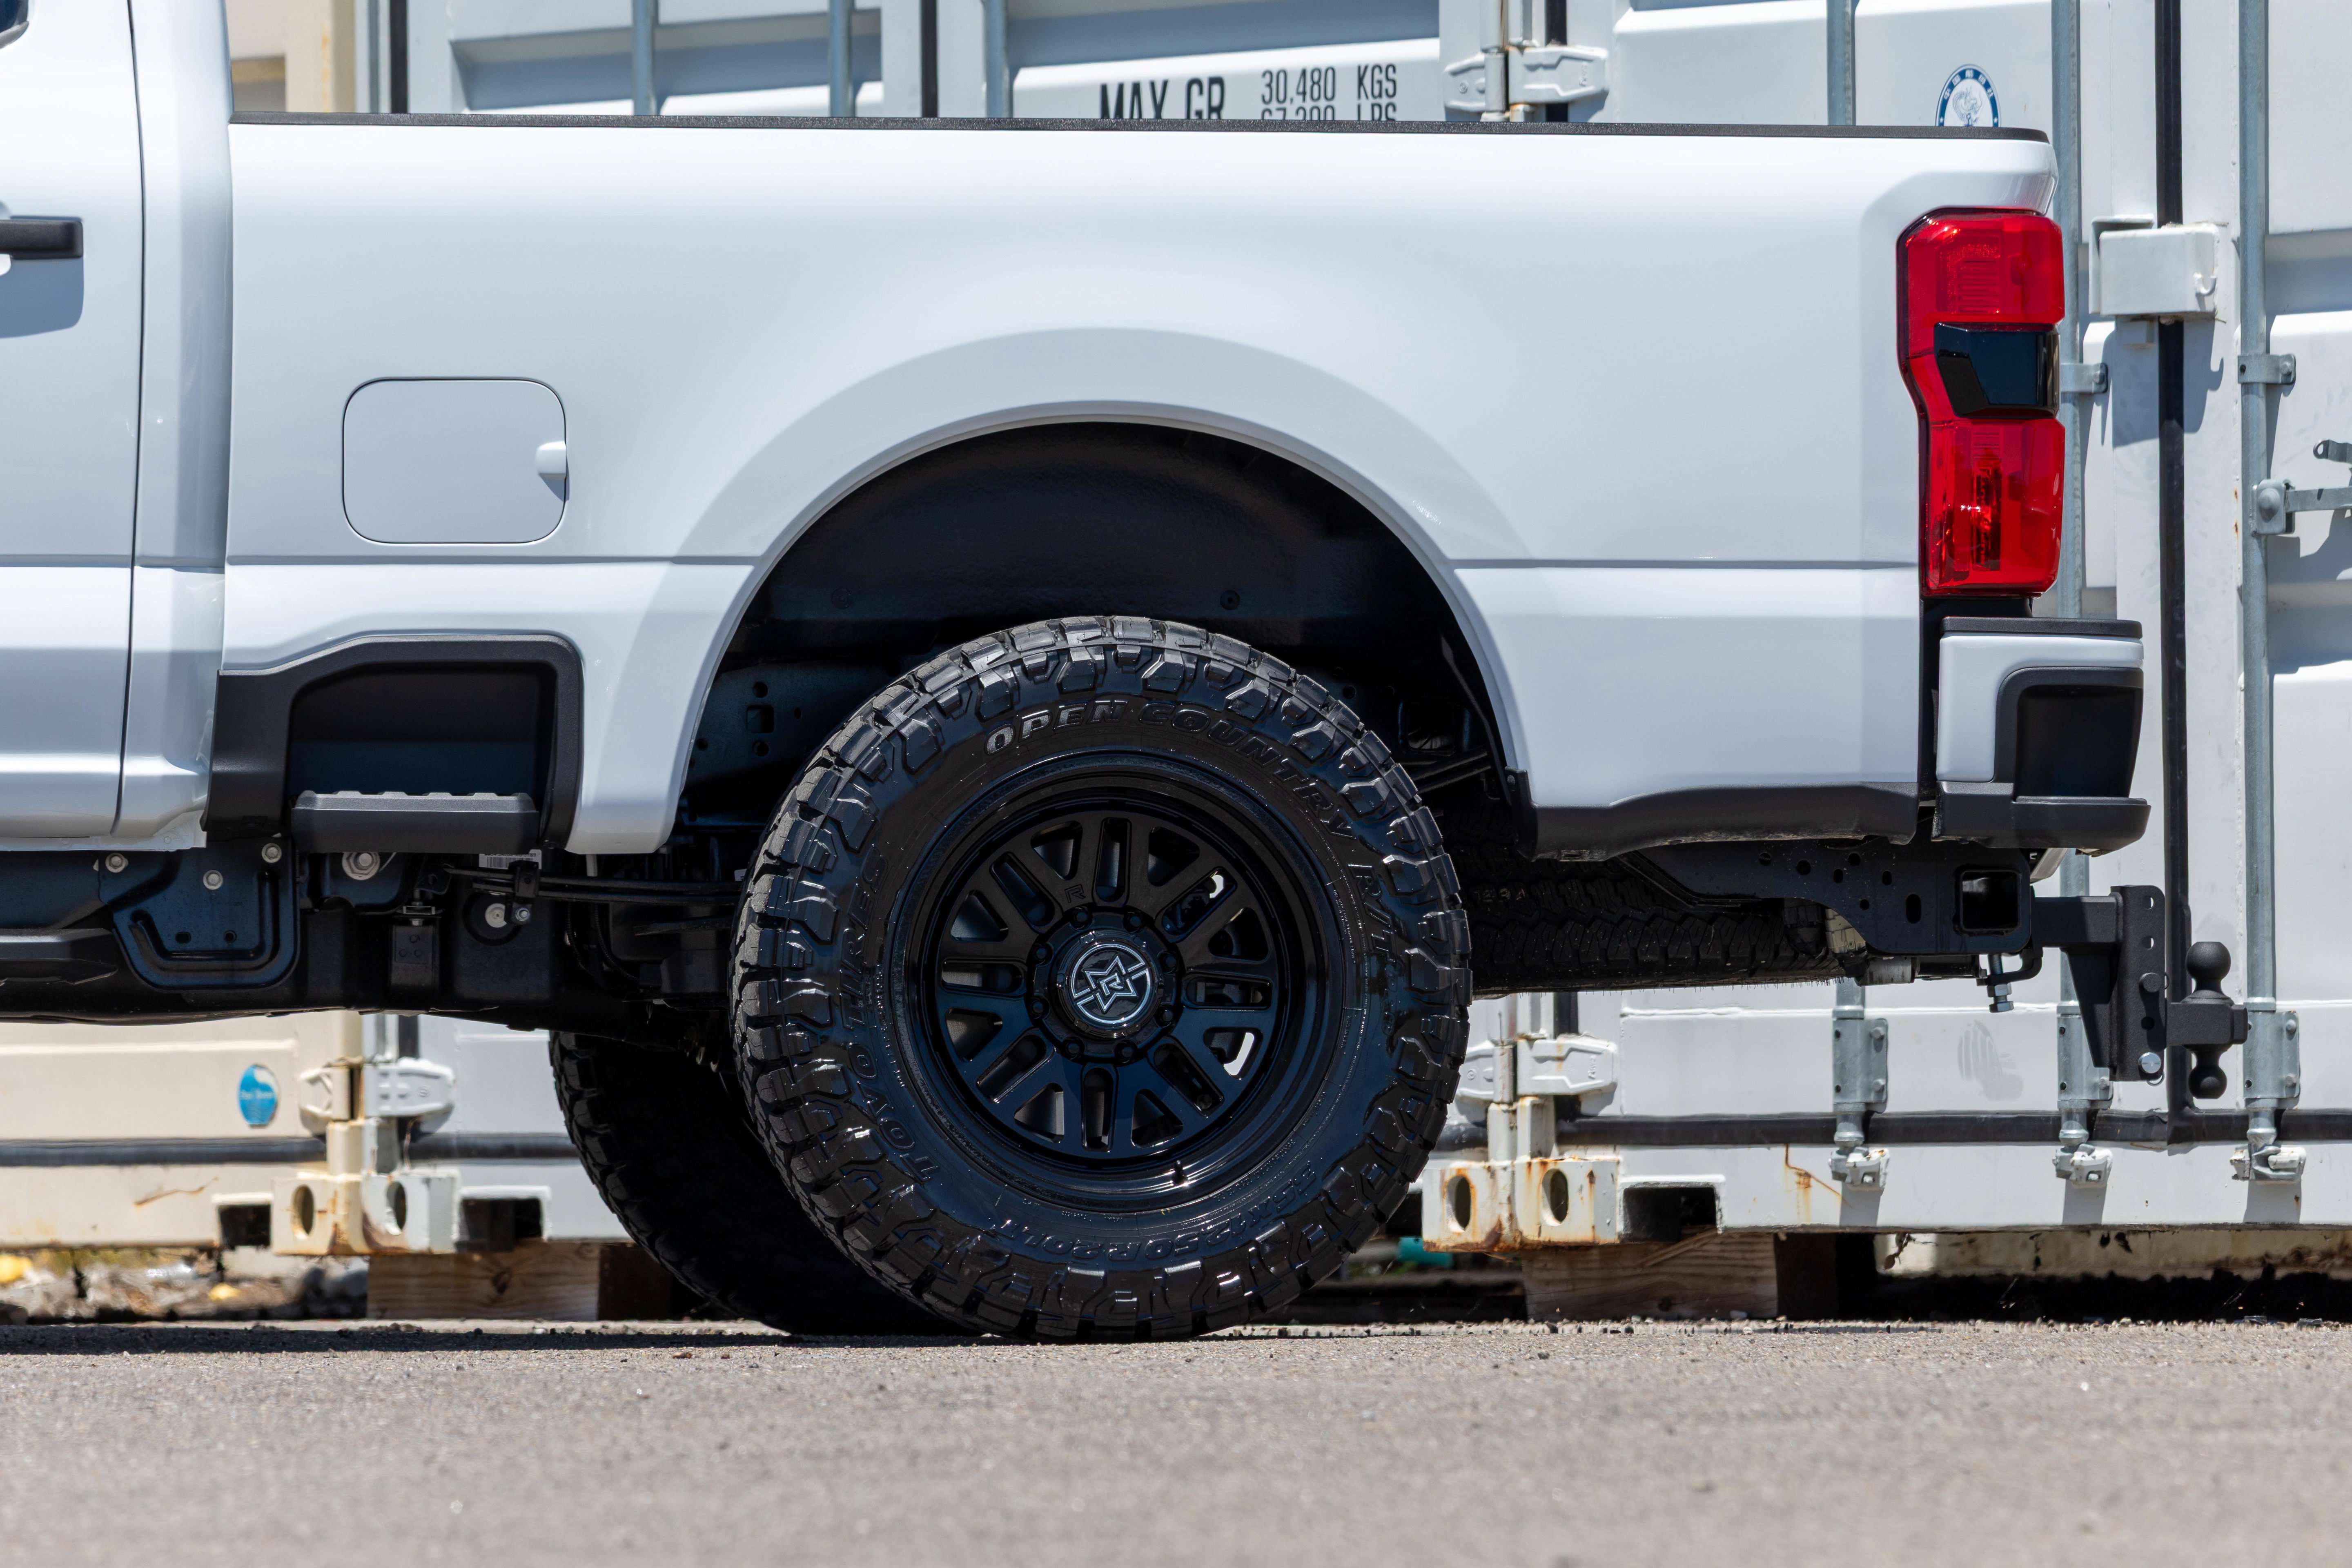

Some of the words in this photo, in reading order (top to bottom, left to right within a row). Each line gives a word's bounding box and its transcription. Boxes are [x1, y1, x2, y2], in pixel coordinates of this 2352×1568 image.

[1100, 79, 1169, 119] MAX
[1185, 76, 1225, 120] GR
[1261, 67, 1336, 105] 30,480
[1357, 64, 1396, 100] KGS
[984, 699, 1129, 757] OPEN
[1137, 700, 1358, 839] COUNTRY
[1347, 864, 1398, 964] R/T
[838, 843, 889, 1028] TIRES
[844, 1042, 939, 1183] TOYO
